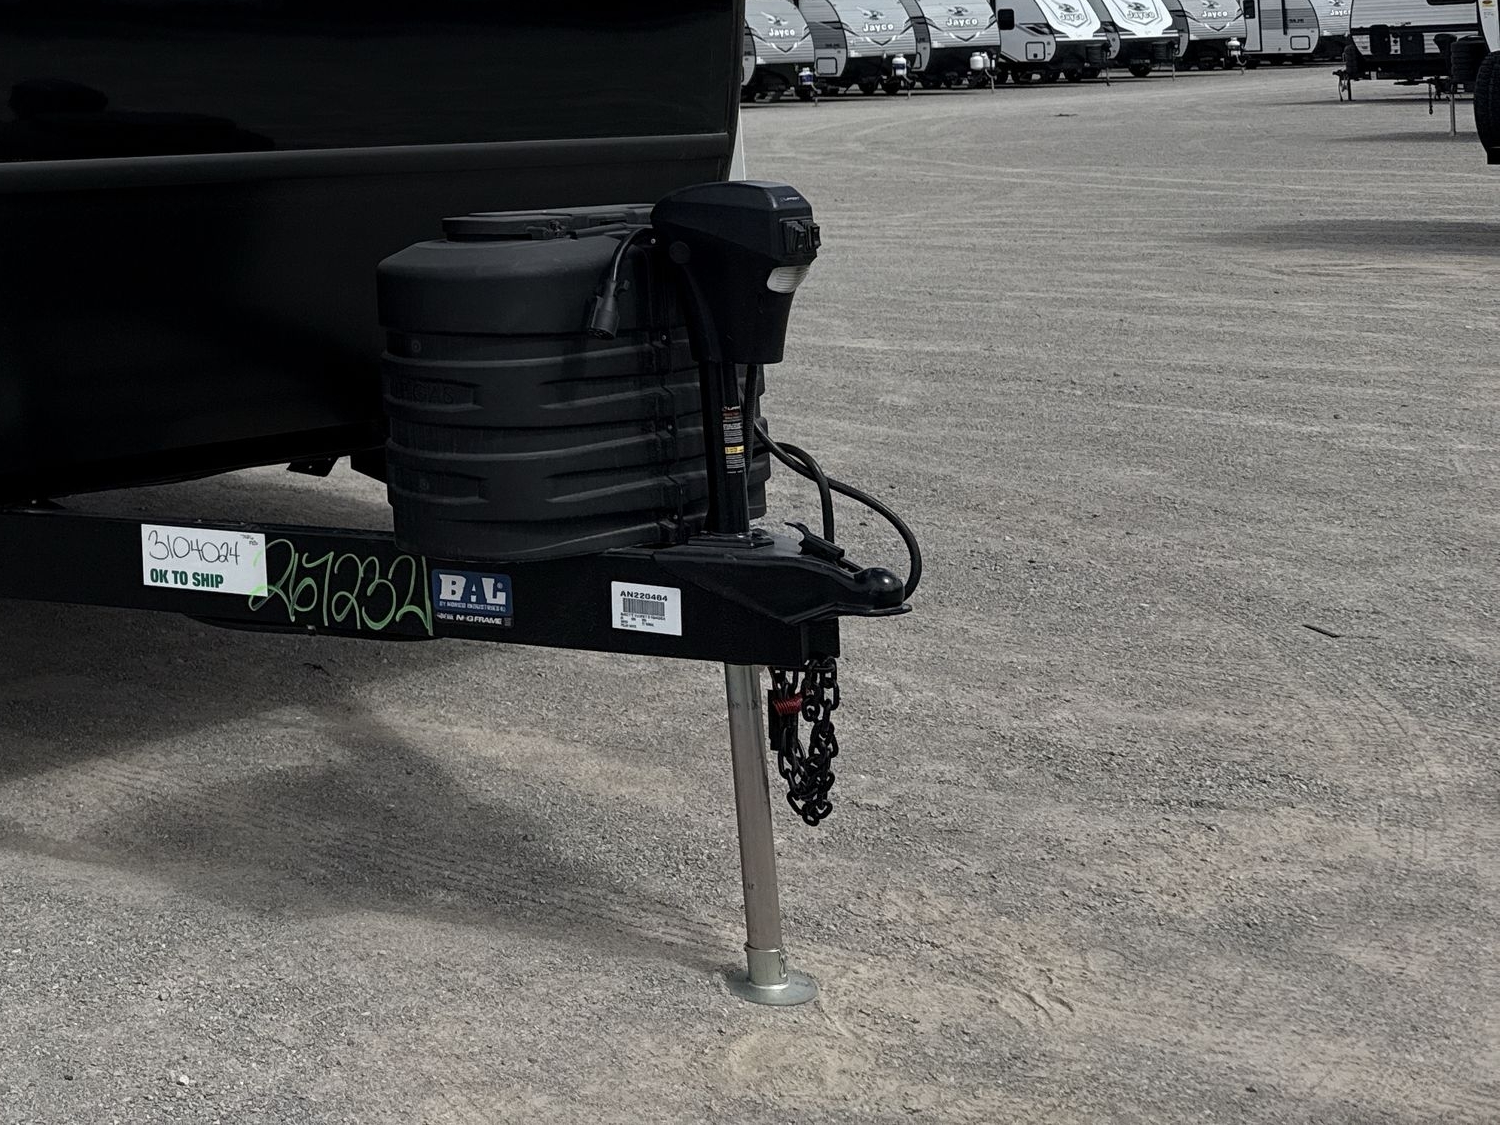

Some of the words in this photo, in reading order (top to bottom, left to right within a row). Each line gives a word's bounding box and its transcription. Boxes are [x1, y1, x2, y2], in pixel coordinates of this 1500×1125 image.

[1126, 10, 1156, 20] Jayco
[1202, 10, 1228, 19] Jayco
[946, 17, 978, 27] Jayco
[768, 28, 796, 38] Jayco
[862, 23, 894, 34] Jayco
[148, 530, 240, 565] 3104024
[150, 568, 169, 583] OK
[171, 570, 189, 586] TO
[192, 571, 224, 589] SHIP
[438, 573, 507, 605] BAL
